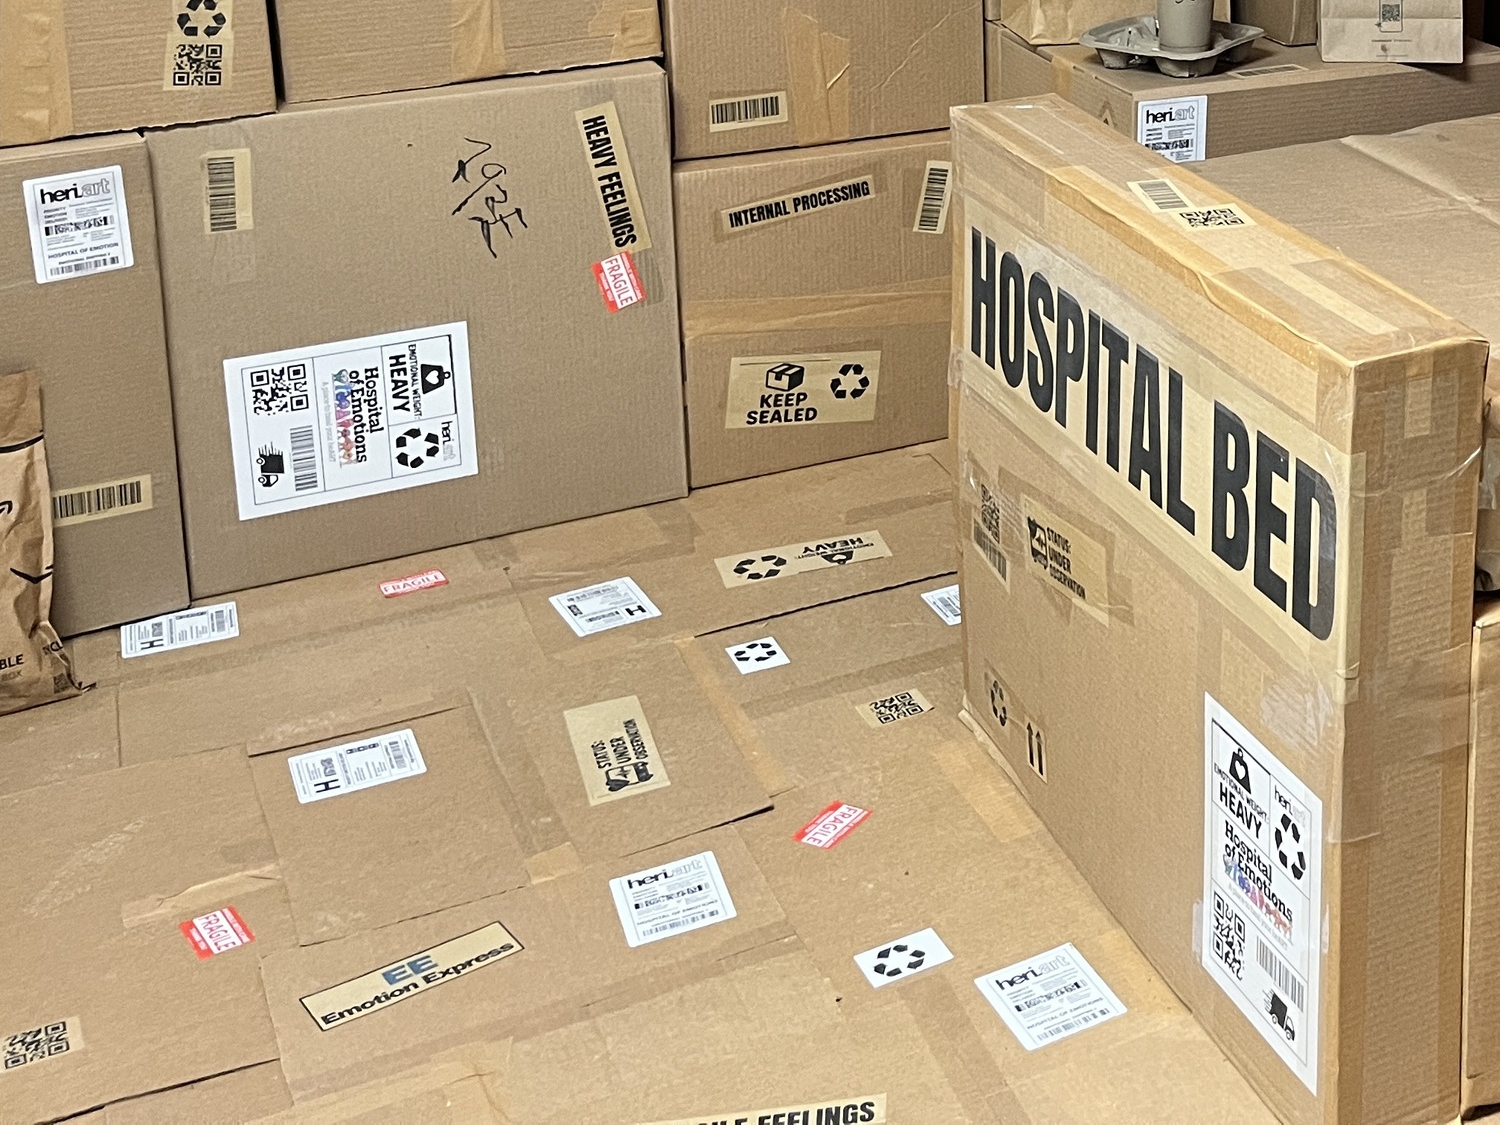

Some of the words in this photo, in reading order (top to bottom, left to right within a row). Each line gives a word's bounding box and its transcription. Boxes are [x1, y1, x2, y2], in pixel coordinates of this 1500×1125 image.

[583, 115, 618, 169] HEAVY
[598, 172, 637, 248] FEELINGS
[728, 197, 791, 229] INTERNAL
[794, 181, 870, 211] PROCESSING
[605, 257, 634, 306] FRAGILE
[349, 370, 361, 382] of
[389, 354, 411, 413] HEAVY
[408, 343, 418, 385] EMOTIONAL
[364, 366, 384, 434] Hospital
[746, 407, 818, 425] SEALED
[760, 391, 808, 408] KEEP
[351, 389, 367, 464] Emotions
[971, 226, 1195, 537] HOSPITAL
[1212, 399, 1338, 642] BED
[803, 537, 863, 554] HEAVY
[1048, 545, 1072, 575] UNDER
[382, 573, 442, 593] FRAGILE
[626, 605, 647, 617] H
[141, 638, 164, 650] H
[610, 736, 631, 765] UNDER
[315, 779, 341, 794] H
[1214, 762, 1244, 801] EMOTIONAL
[806, 804, 858, 846] FRAGILE
[1220, 781, 1262, 839] HEAVY
[1225, 820, 1272, 884] Hospital
[1225, 843, 1236, 858] of
[1237, 852, 1293, 922] Emotions
[198, 912, 237, 953] FRAGILE
[320, 982, 420, 1025] Emotion
[421, 942, 515, 985] Express
[382, 955, 440, 985] EE
